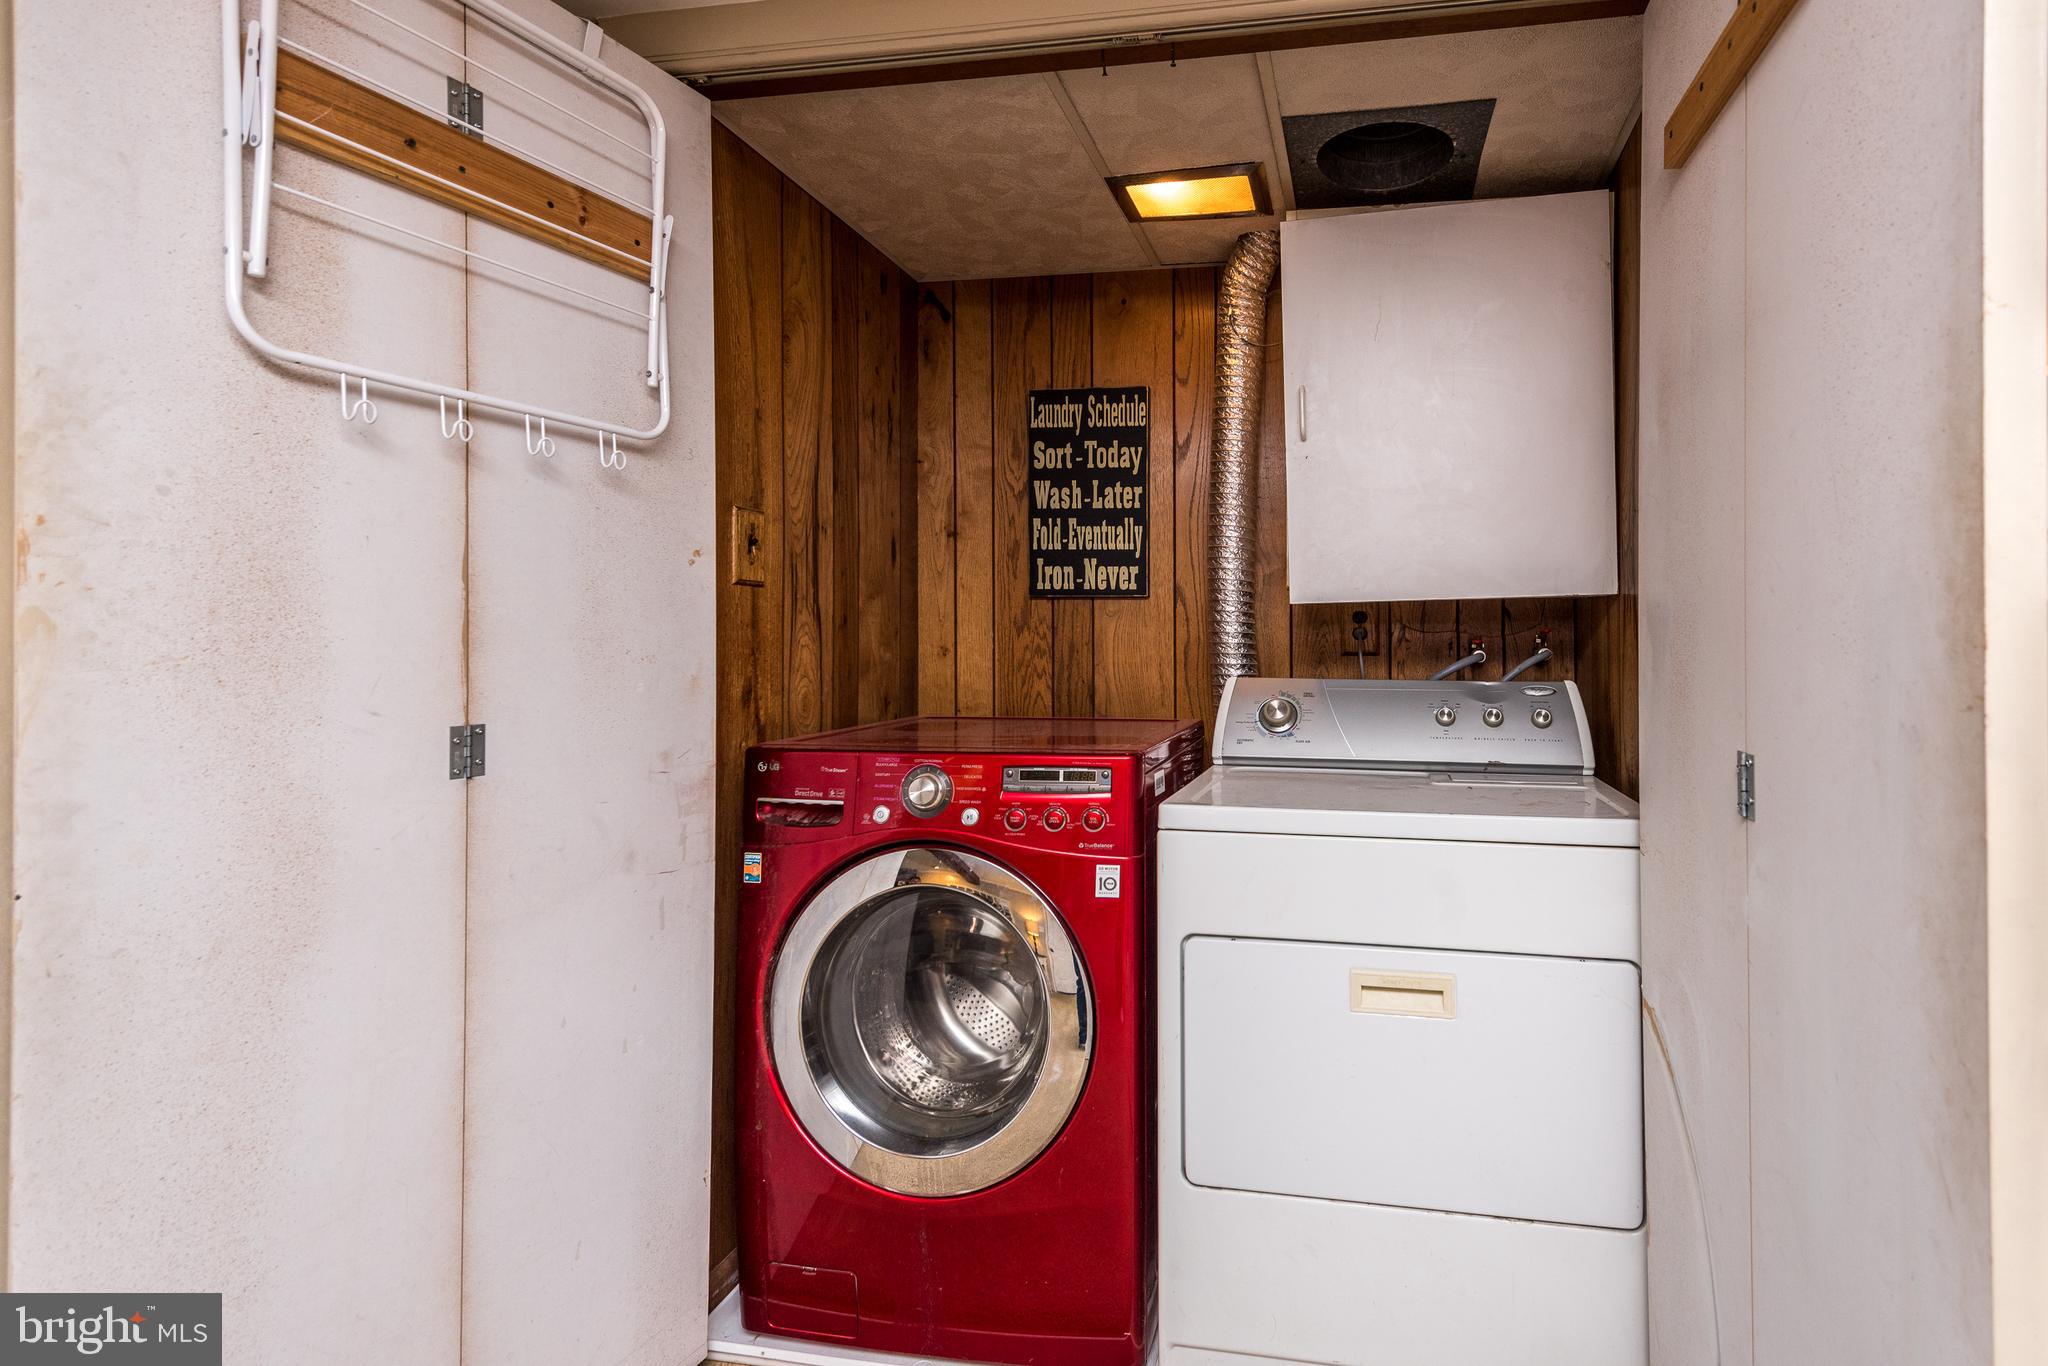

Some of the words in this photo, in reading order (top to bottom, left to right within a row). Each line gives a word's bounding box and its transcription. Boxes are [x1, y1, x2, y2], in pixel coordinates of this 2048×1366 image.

[1030, 396, 1082, 436] Laundry
[1087, 394, 1146, 428] Schedule
[1098, 876, 1117, 891] 10
